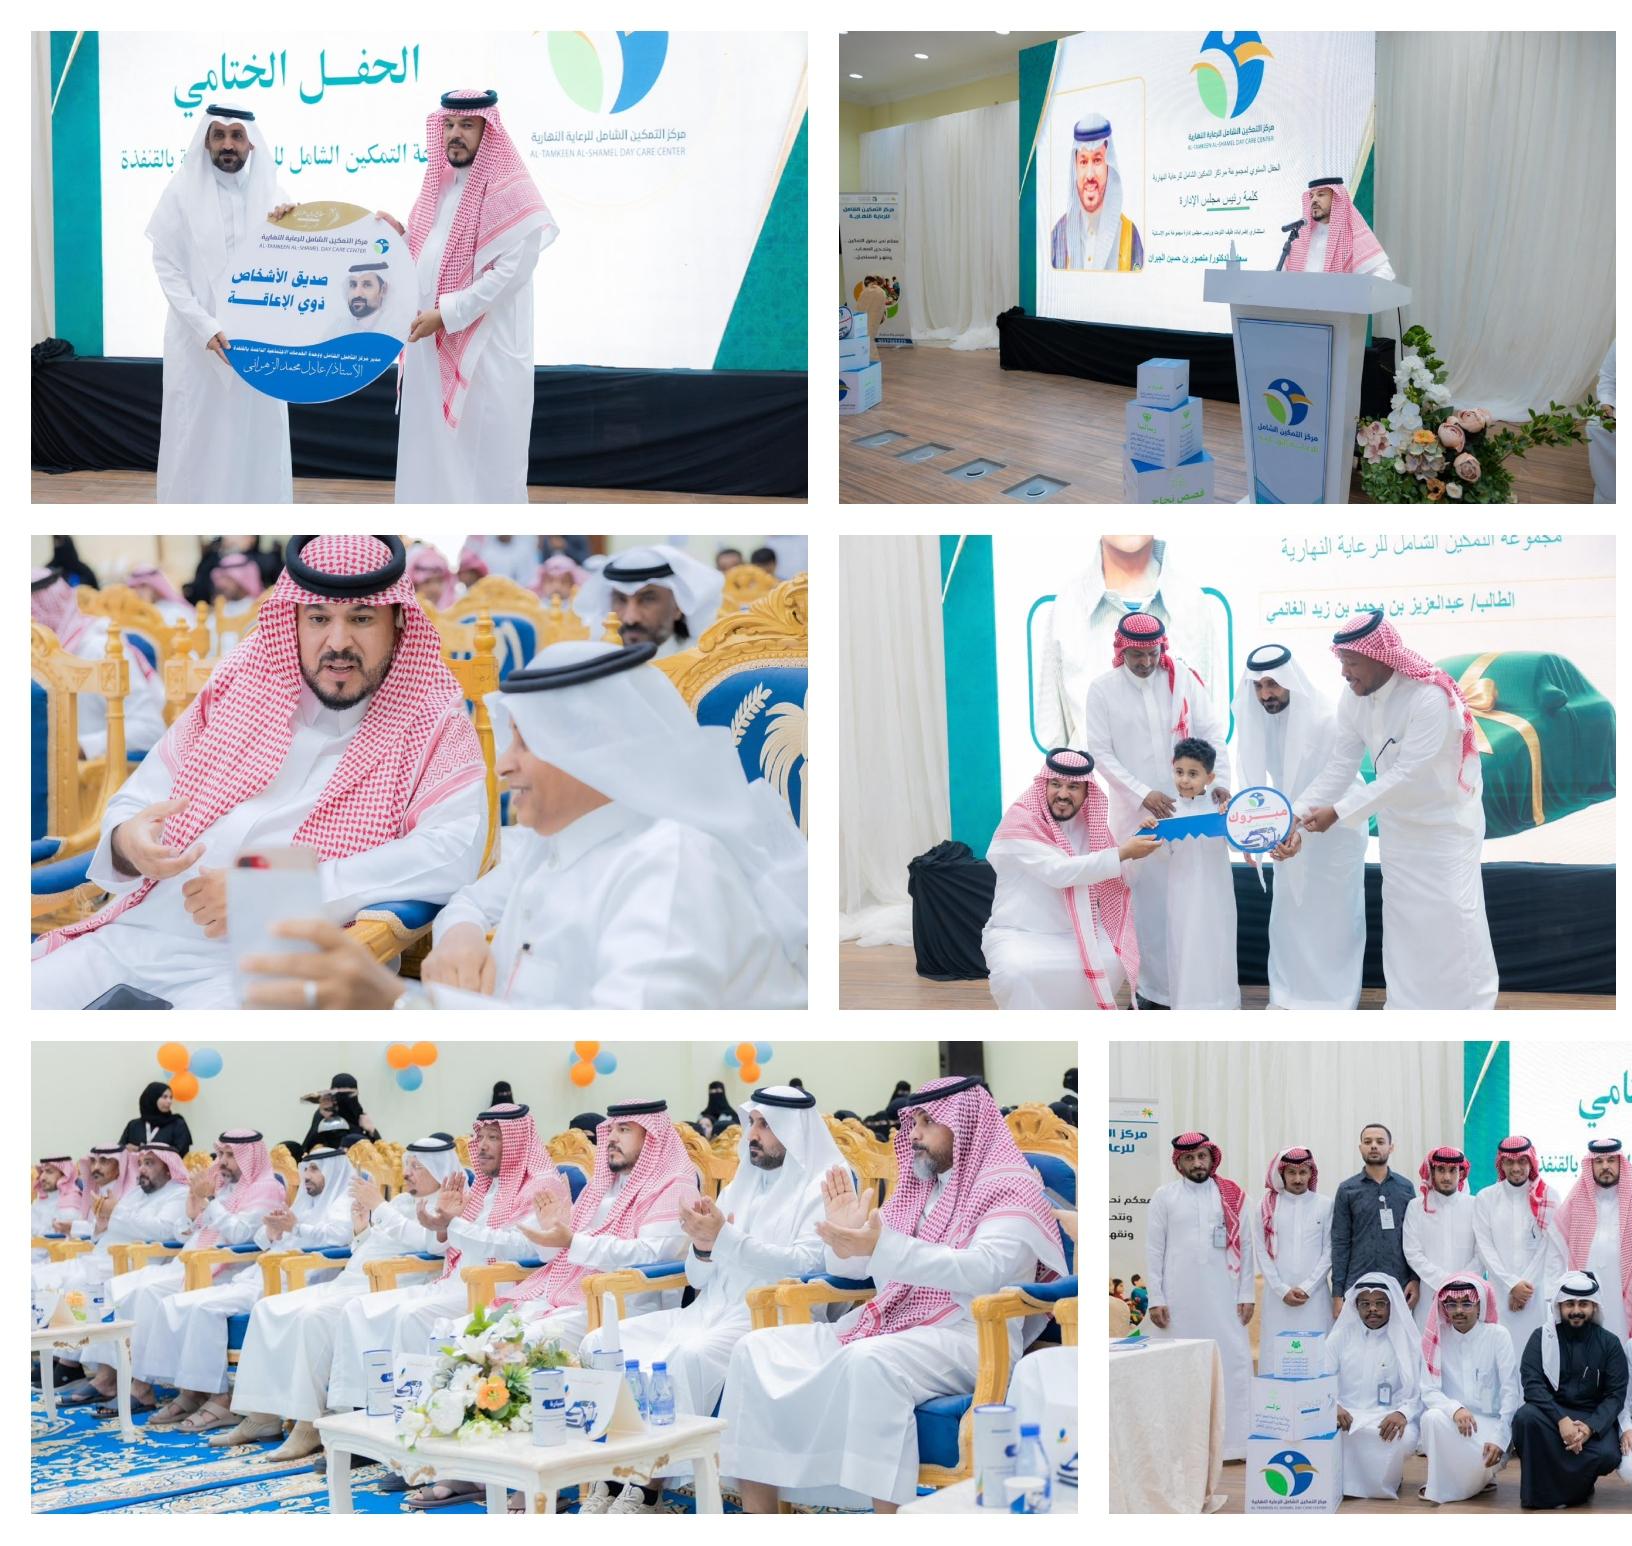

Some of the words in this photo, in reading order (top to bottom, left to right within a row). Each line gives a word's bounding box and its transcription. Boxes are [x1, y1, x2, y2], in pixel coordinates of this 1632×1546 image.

[299, 43, 419, 105] الحفل
[174, 49, 287, 118] الختامي
[596, 129, 628, 143] الشامل
[630, 129, 665, 142] التمكين
[667, 128, 687, 141] مركز
[1263, 123, 1275, 133] مركز
[531, 131, 564, 144] النهارية
[566, 131, 593, 144] للرعاية
[290, 143, 340, 174] الشامل
[345, 143, 407, 173] التمكين
[619, 147, 635, 157] DAY
[636, 147, 655, 157] CARE
[656, 146, 686, 156] CENTER
[231, 267, 288, 284] الأشخاص
[291, 270, 328, 288] صديق
[227, 290, 294, 311] الإعاقة
[298, 296, 325, 315] ذوي
[1281, 536, 1332, 562] النهارية
[1337, 535, 1387, 559] للرعاية
[1312, 601, 1330, 618] زيد
[1334, 601, 1350, 619] بن
[1390, 600, 1404, 617] بن
[1120, 1129, 1148, 1140] مركز
[1109, 1143, 1135, 1154] للرعا
[1538, 1154, 1579, 1178] بالقنفذ
[1109, 1213, 1133, 1223] ونتح
[1109, 1230, 1134, 1240] ونقه
